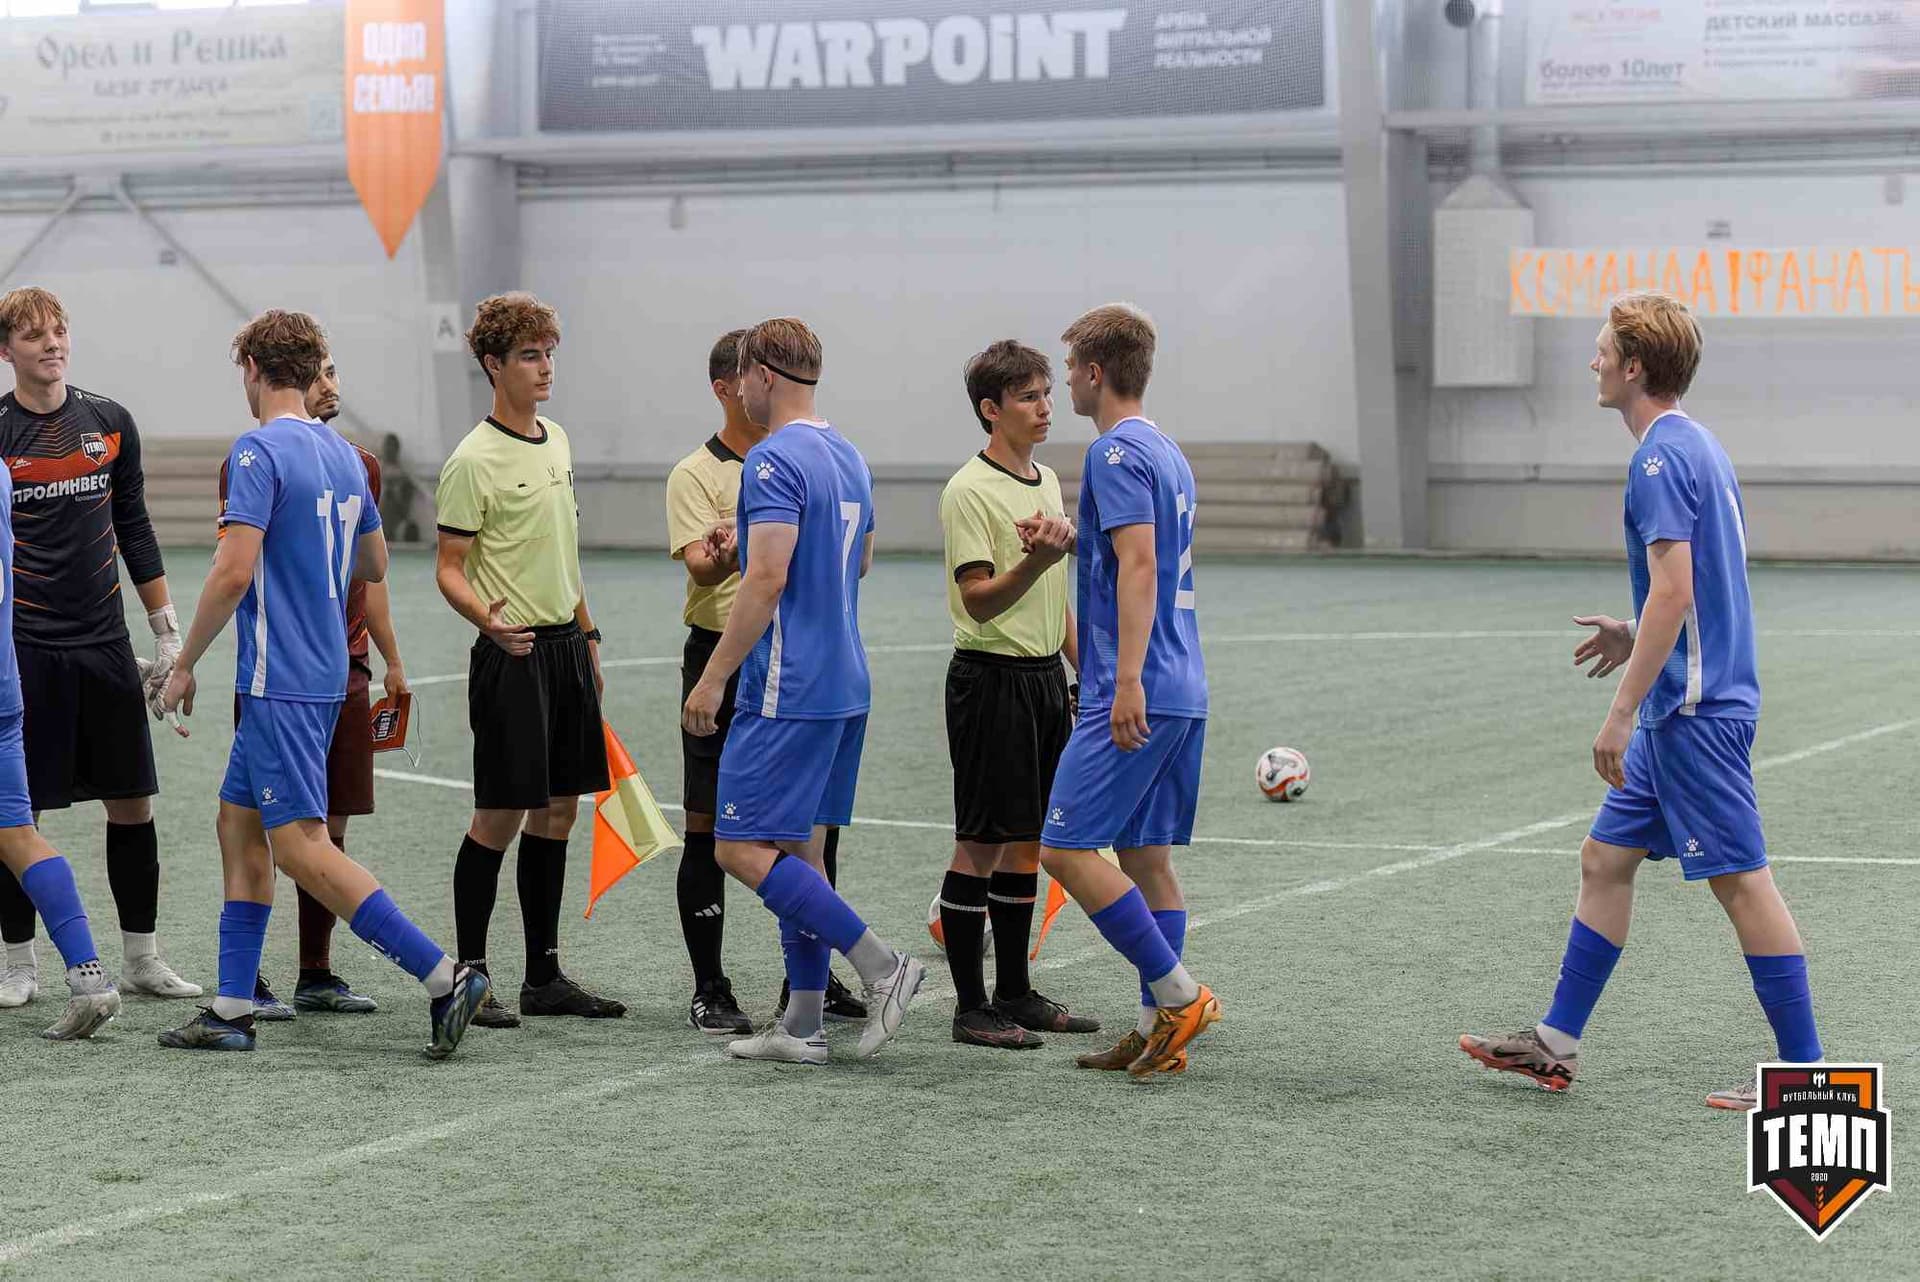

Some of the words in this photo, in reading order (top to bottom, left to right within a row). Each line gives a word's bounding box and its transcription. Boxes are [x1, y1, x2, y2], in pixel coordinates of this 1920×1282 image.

[1704, 12, 1798, 31] ДЕТСКИЙ
[36, 35, 118, 80] Орел
[132, 40, 152, 66] и
[171, 28, 288, 65] Решка
[363, 22, 426, 69] ОДНА
[1540, 58, 1612, 79] более
[353, 73, 435, 113] СЕМЬЯ!
[316, 489, 362, 599] 11
[839, 501, 861, 613] 7
